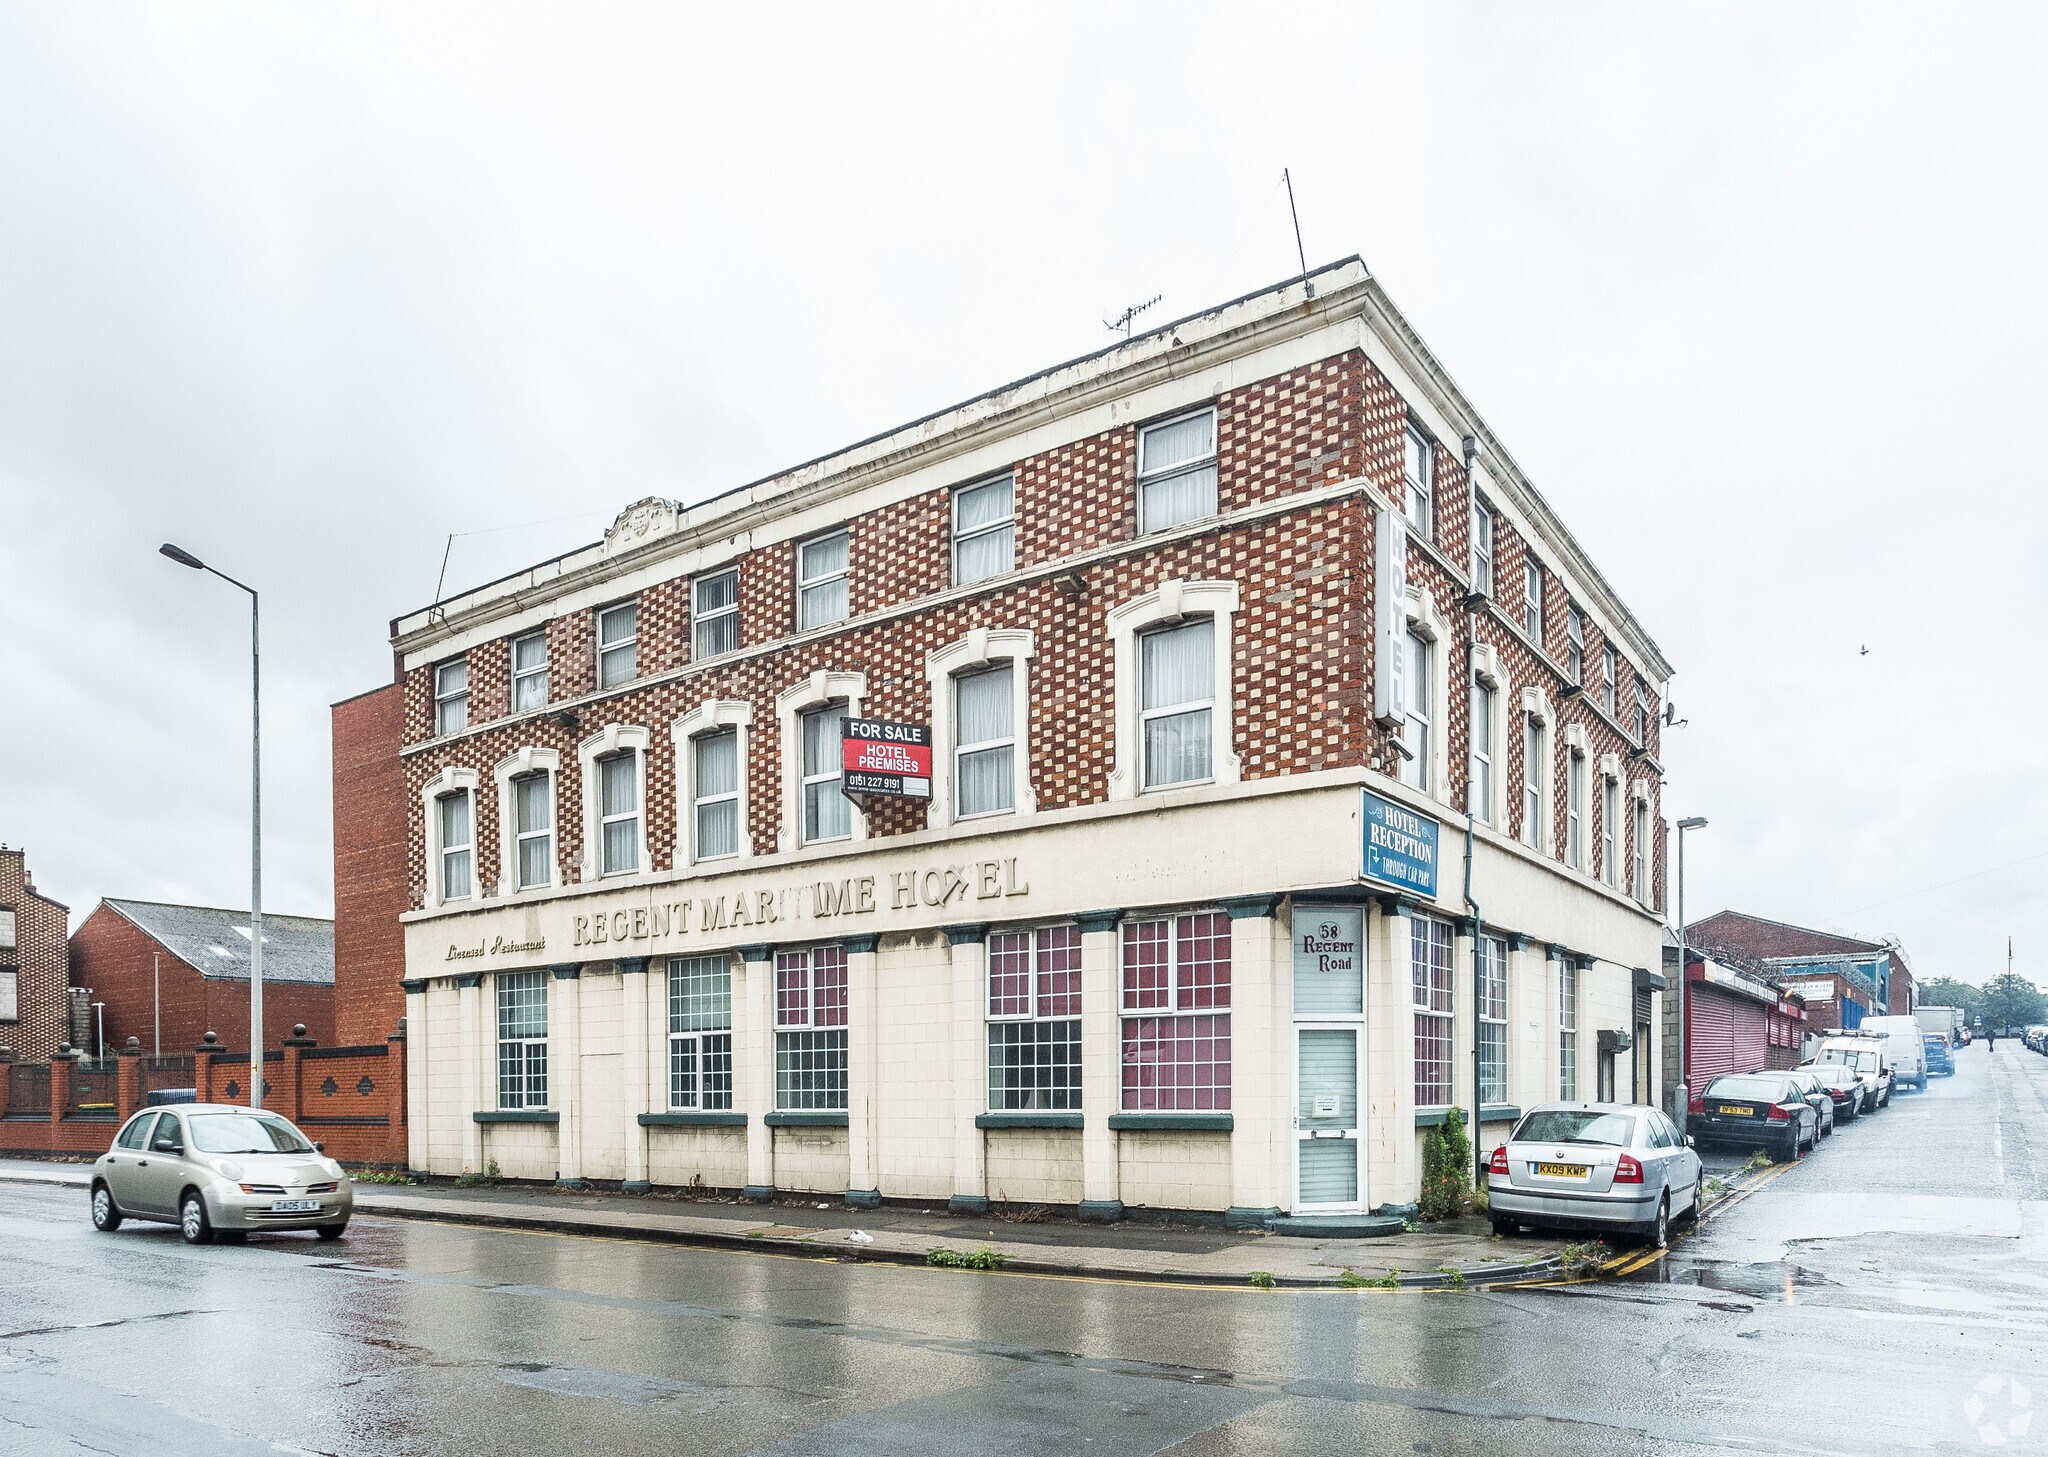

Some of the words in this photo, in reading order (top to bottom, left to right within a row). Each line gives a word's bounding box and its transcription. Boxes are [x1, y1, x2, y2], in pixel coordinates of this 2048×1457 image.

[1392, 523, 1403, 713] HOTEL
[850, 722, 881, 738] FOR
[884, 725, 922, 742] SALE
[866, 744, 911, 760] HOTEL
[858, 755, 919, 773] PREMISES
[849, 775, 866, 786] 0151
[867, 776, 882, 787] 227
[884, 778, 900, 789] 9191
[1384, 805, 1421, 838] HOTEL
[1370, 822, 1432, 864] RECEPTION
[1382, 856, 1407, 880] THROUGH
[1408, 865, 1418, 883] CAR
[1418, 869, 1430, 888] PARK
[572, 898, 692, 946] REGENT
[1321, 925, 1338, 939] 58
[445, 938, 485, 961] Licensed
[490, 934, 546, 955] Restaurant
[1318, 954, 1352, 973] Road
[1540, 1164, 1565, 1175] KX09
[1566, 1166, 1586, 1177] KWP
